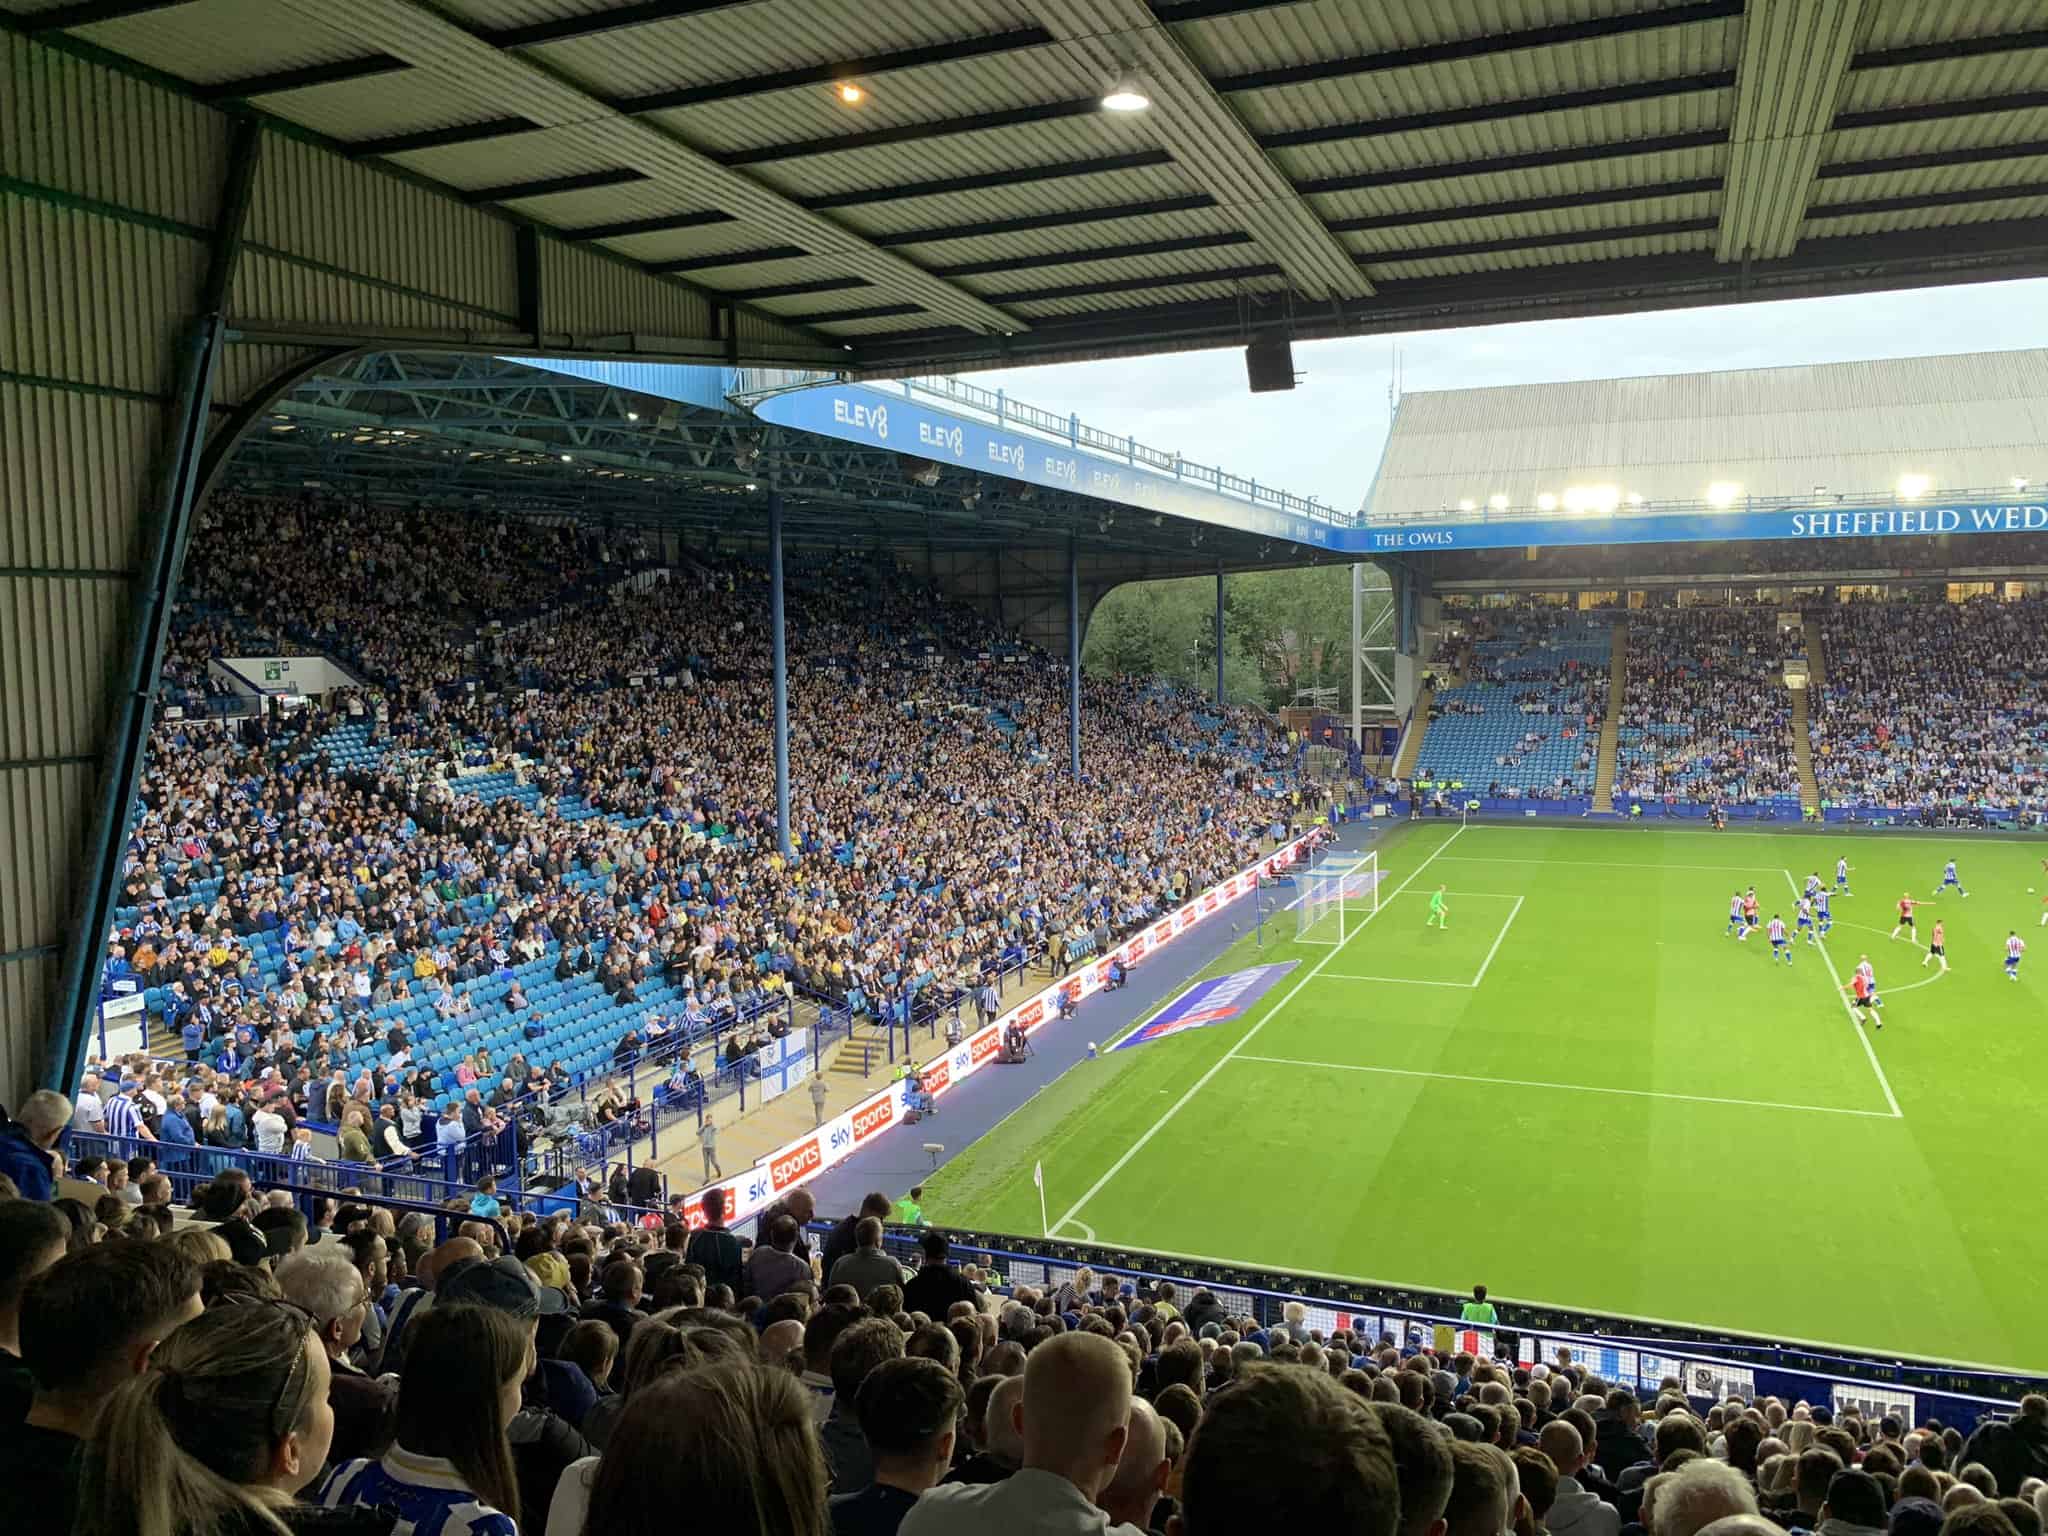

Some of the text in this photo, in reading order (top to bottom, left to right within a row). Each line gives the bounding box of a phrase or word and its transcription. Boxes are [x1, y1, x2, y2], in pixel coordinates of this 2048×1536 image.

[834, 398, 888, 440] ELEV8
[919, 421, 963, 457] ELEV8
[988, 440, 1025, 473] ELEV8
[1791, 505, 2048, 536] SHEFFIELD WED
[1374, 531, 1454, 547] THE OWLS
[831, 1102, 891, 1149] sky sports
[773, 1145, 819, 1184] sports
